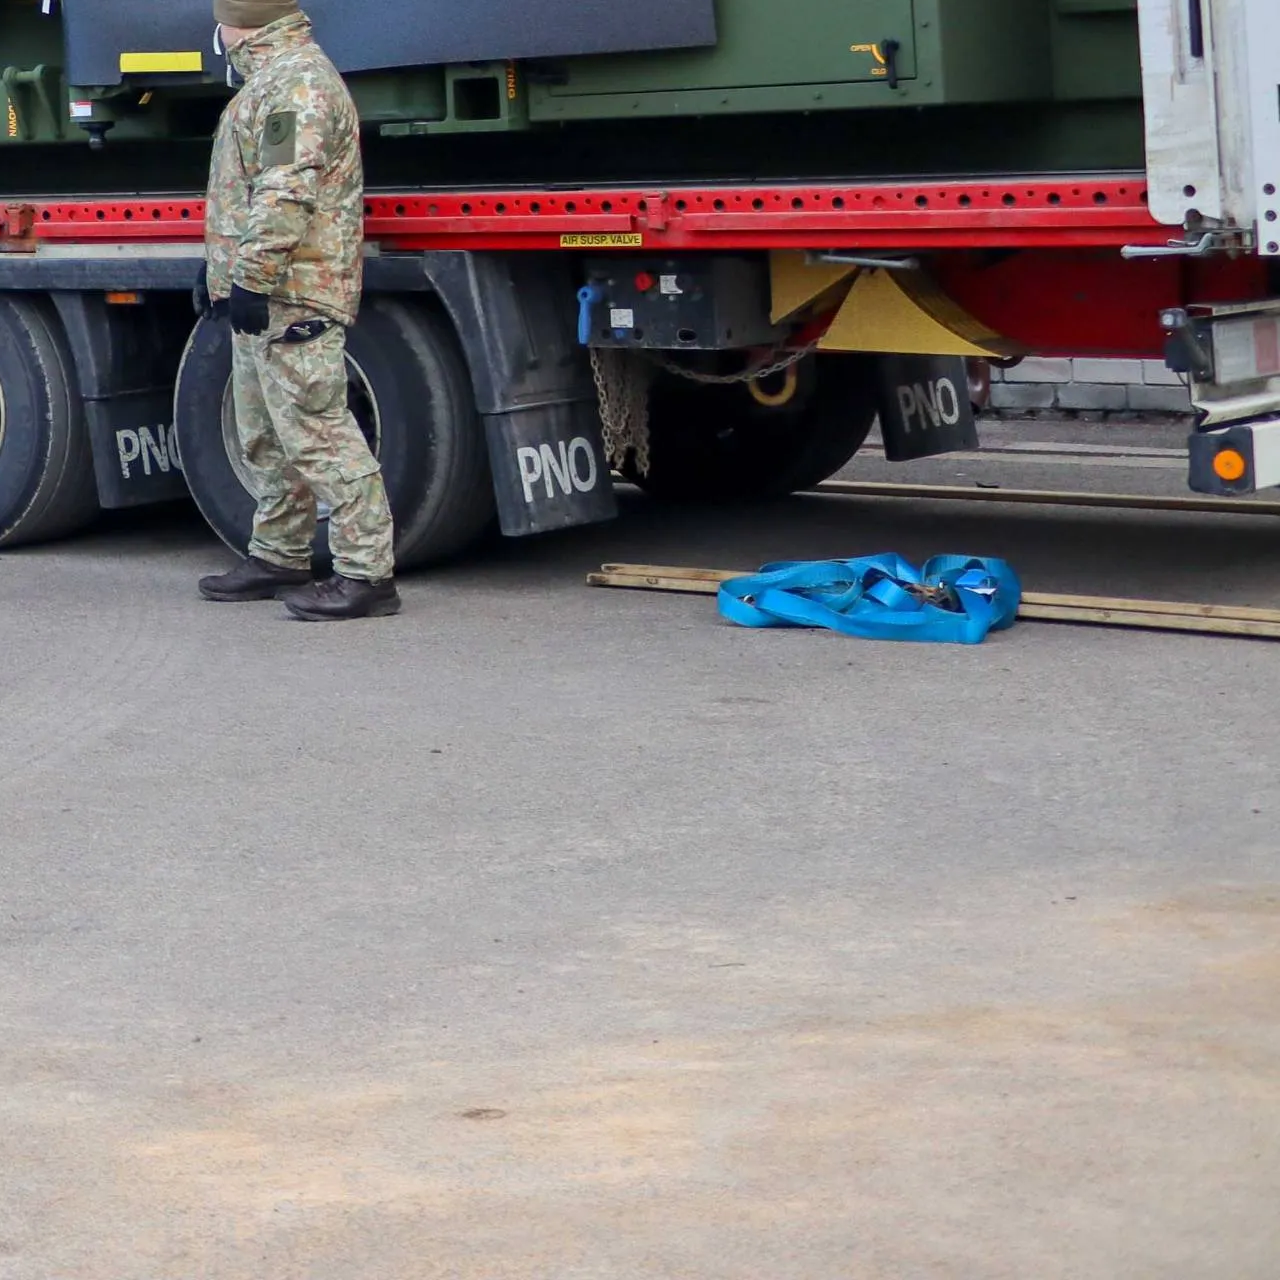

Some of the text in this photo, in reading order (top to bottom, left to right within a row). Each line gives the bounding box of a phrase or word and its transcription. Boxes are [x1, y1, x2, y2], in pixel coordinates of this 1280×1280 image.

[561, 236, 578, 245] AIR
[608, 235, 641, 244] VALVE
[897, 377, 959, 434] PNO
[517, 436, 597, 503] PNO
